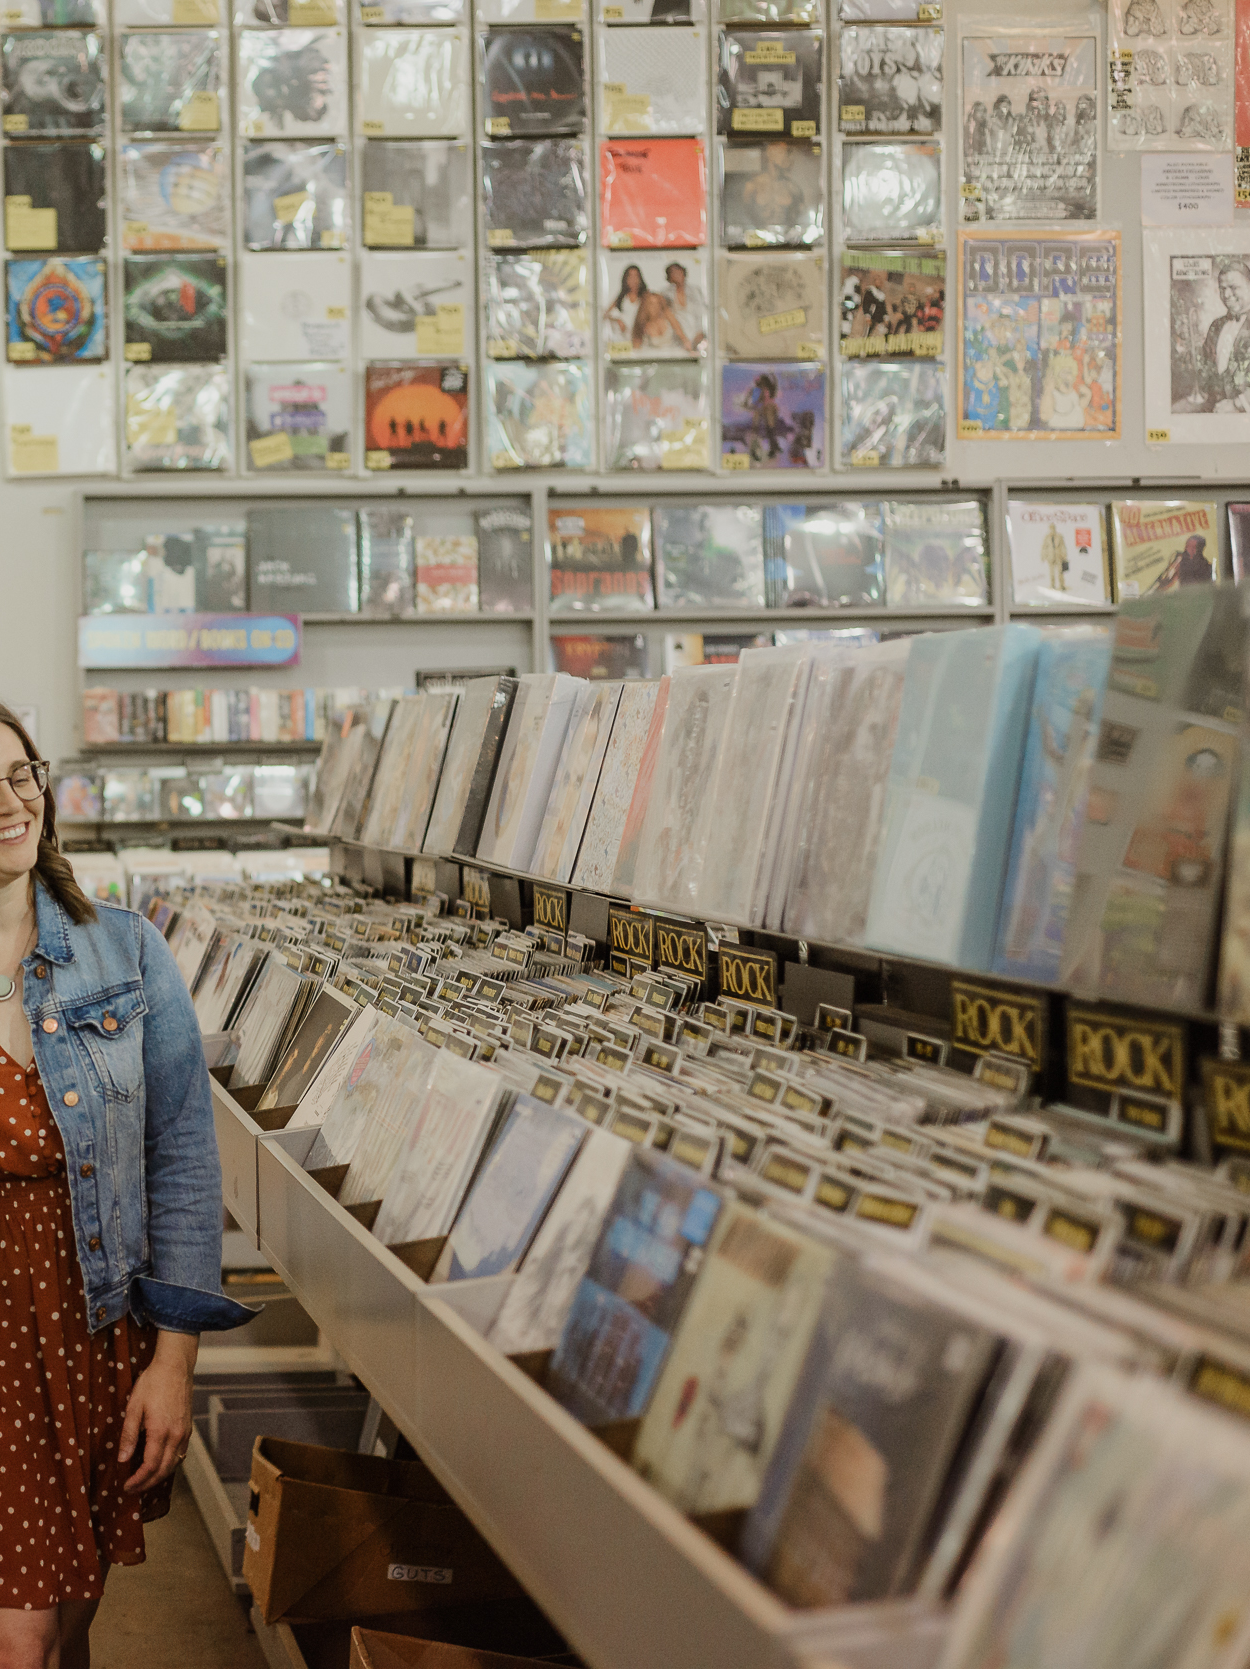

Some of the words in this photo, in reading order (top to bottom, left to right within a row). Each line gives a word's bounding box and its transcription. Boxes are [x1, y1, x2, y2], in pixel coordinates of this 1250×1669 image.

[1003, 56, 1068, 76] KINKS
[1123, 509, 1211, 548] ALTERNATIVE
[535, 893, 563, 928] ROCK
[612, 917, 649, 955] ROCK
[659, 930, 703, 971] ROCK
[721, 956, 773, 1001] ROCK
[954, 997, 1039, 1059] ROCK
[1073, 1023, 1177, 1092] ROCK
[391, 1566, 446, 1581] GUTS
